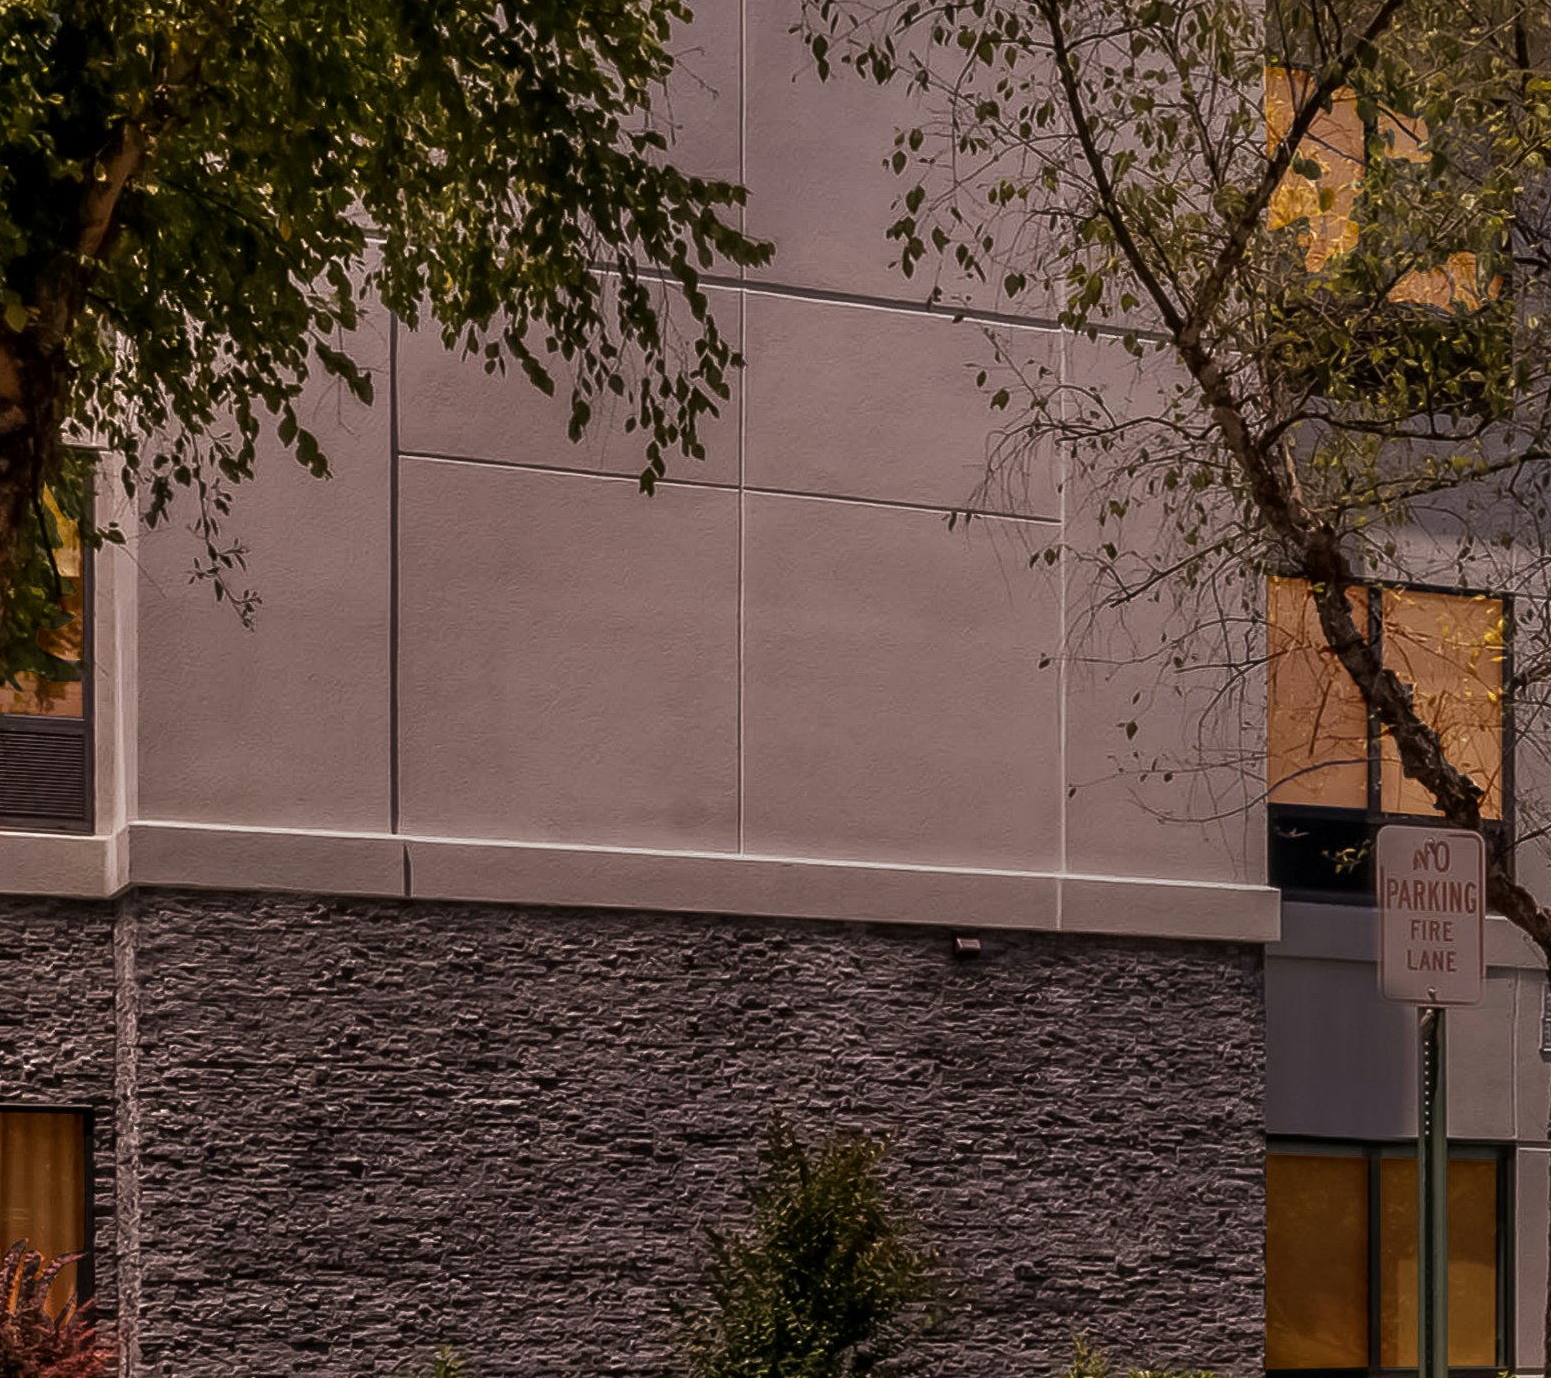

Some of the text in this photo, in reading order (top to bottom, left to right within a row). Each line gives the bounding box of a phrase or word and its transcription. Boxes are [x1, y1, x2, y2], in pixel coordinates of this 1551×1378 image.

[1413, 840, 1450, 872] NO
[1386, 878, 1477, 914] PARKING
[1410, 919, 1454, 942] FIRE
[1406, 949, 1456, 972] LANE
